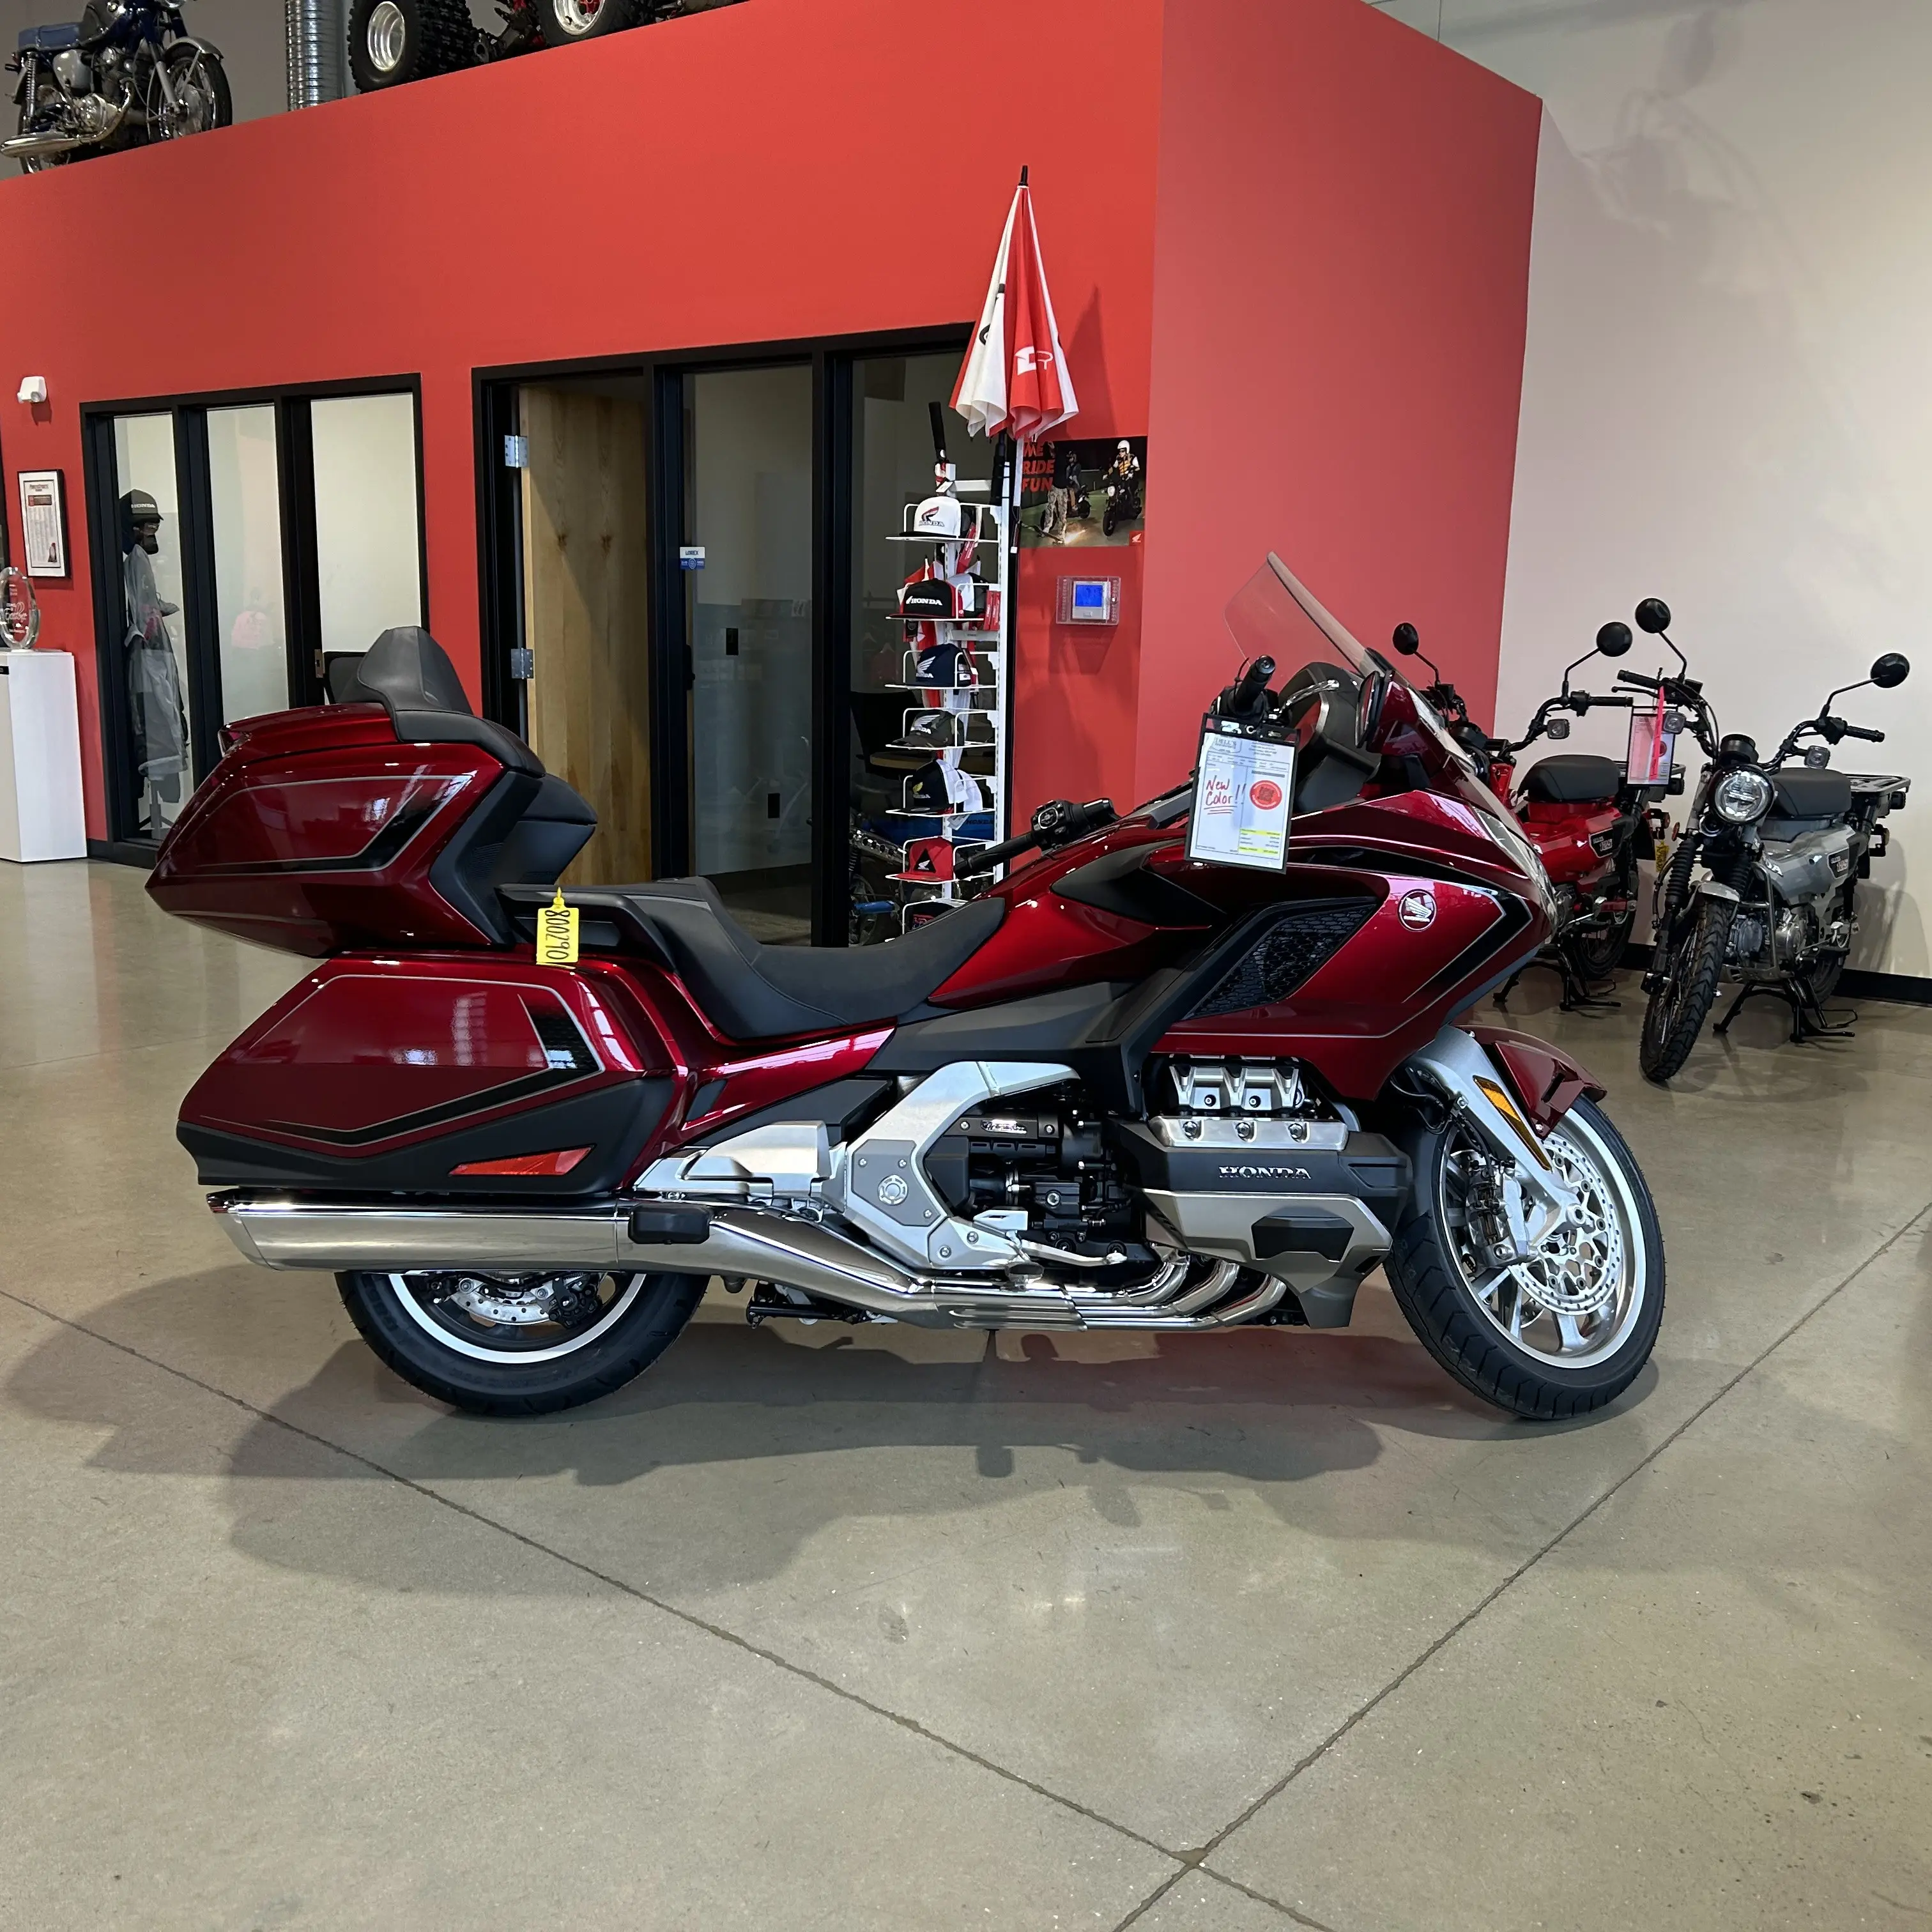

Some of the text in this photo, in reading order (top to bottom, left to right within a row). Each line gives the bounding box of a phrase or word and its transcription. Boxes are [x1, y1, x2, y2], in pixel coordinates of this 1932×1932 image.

[1022, 459, 1055, 474] RIDE
[1022, 477, 1053, 493] FUN
[911, 597, 943, 606] HONDA
[1206, 775, 1230, 791] New
[545, 910, 570, 960] 800290
[1218, 1166, 1312, 1179] HONDA
